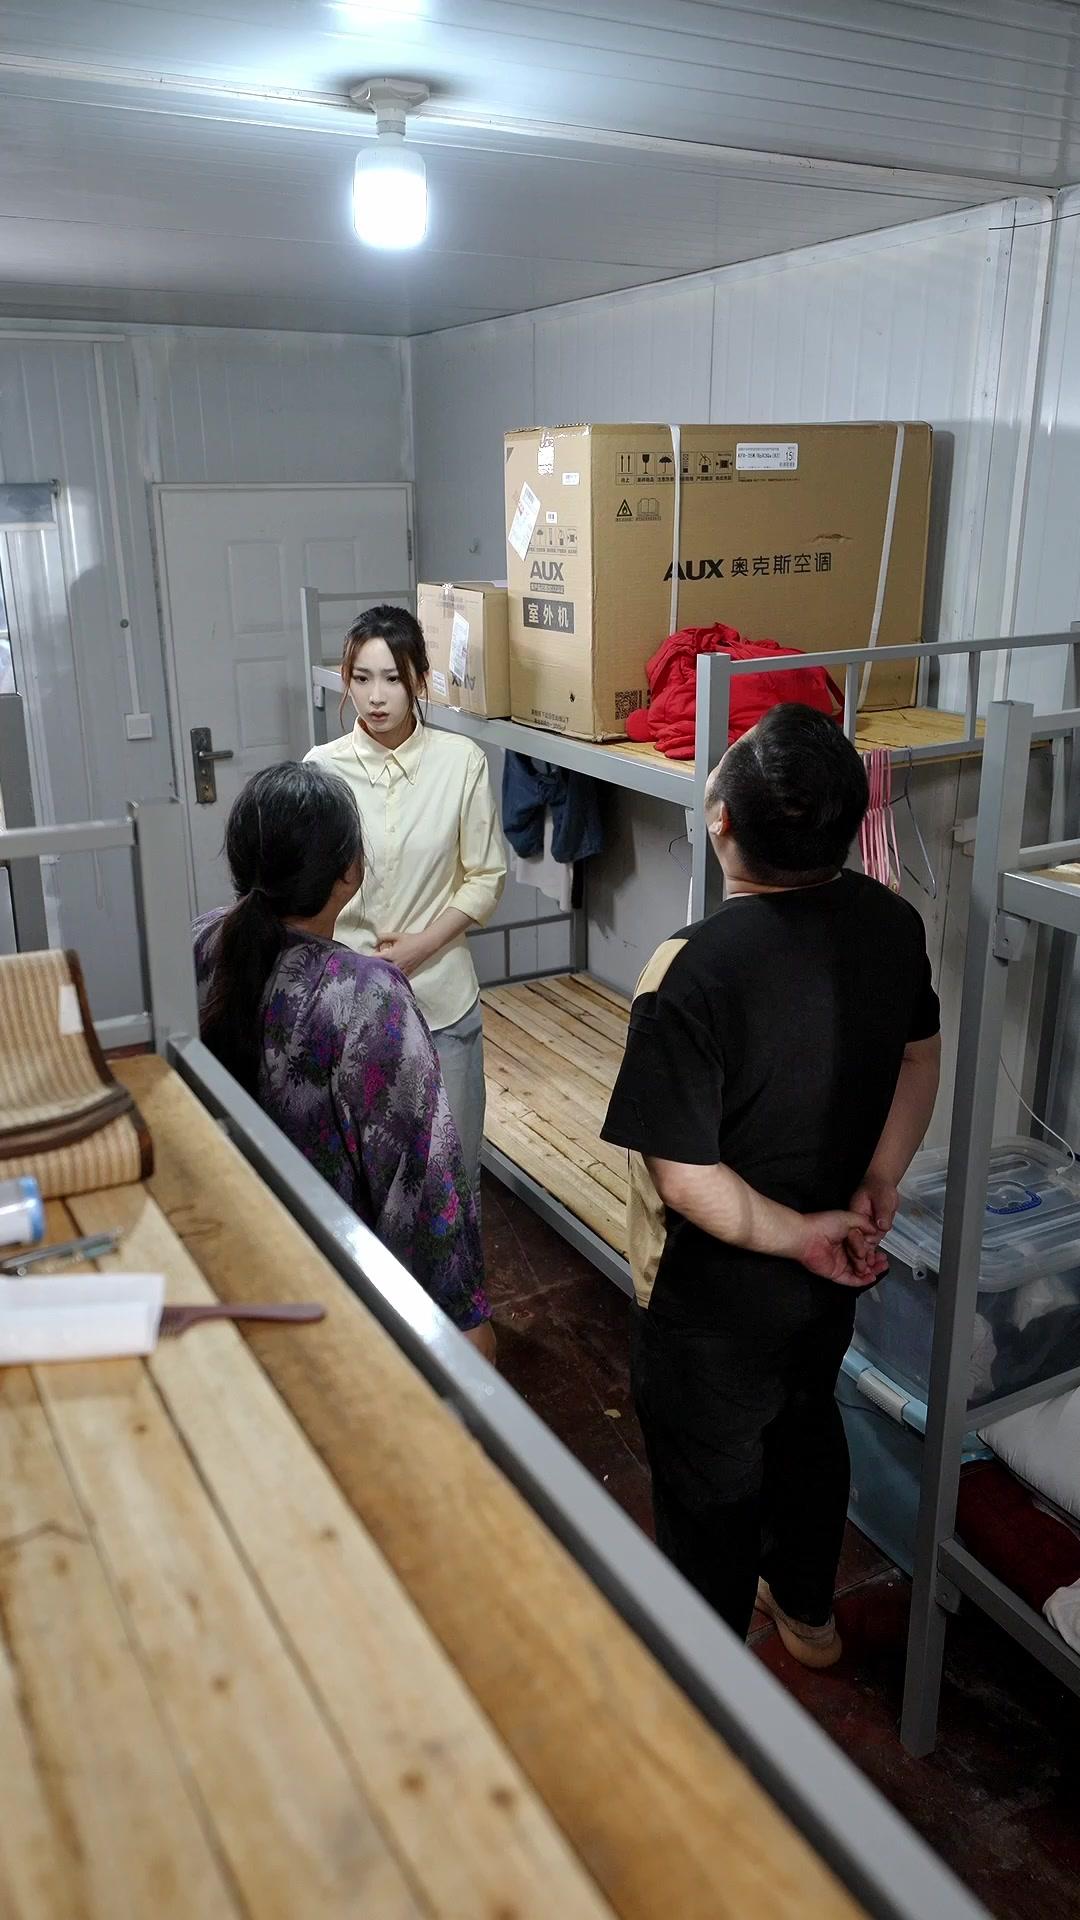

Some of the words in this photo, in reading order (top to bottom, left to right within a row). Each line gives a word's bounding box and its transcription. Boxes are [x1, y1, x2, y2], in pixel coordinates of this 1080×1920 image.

[530, 560, 564, 581] AUX
[663, 558, 724, 582] AUX
[731, 552, 832, 578] 奥克斯空调
[528, 602, 569, 628] 室外机
